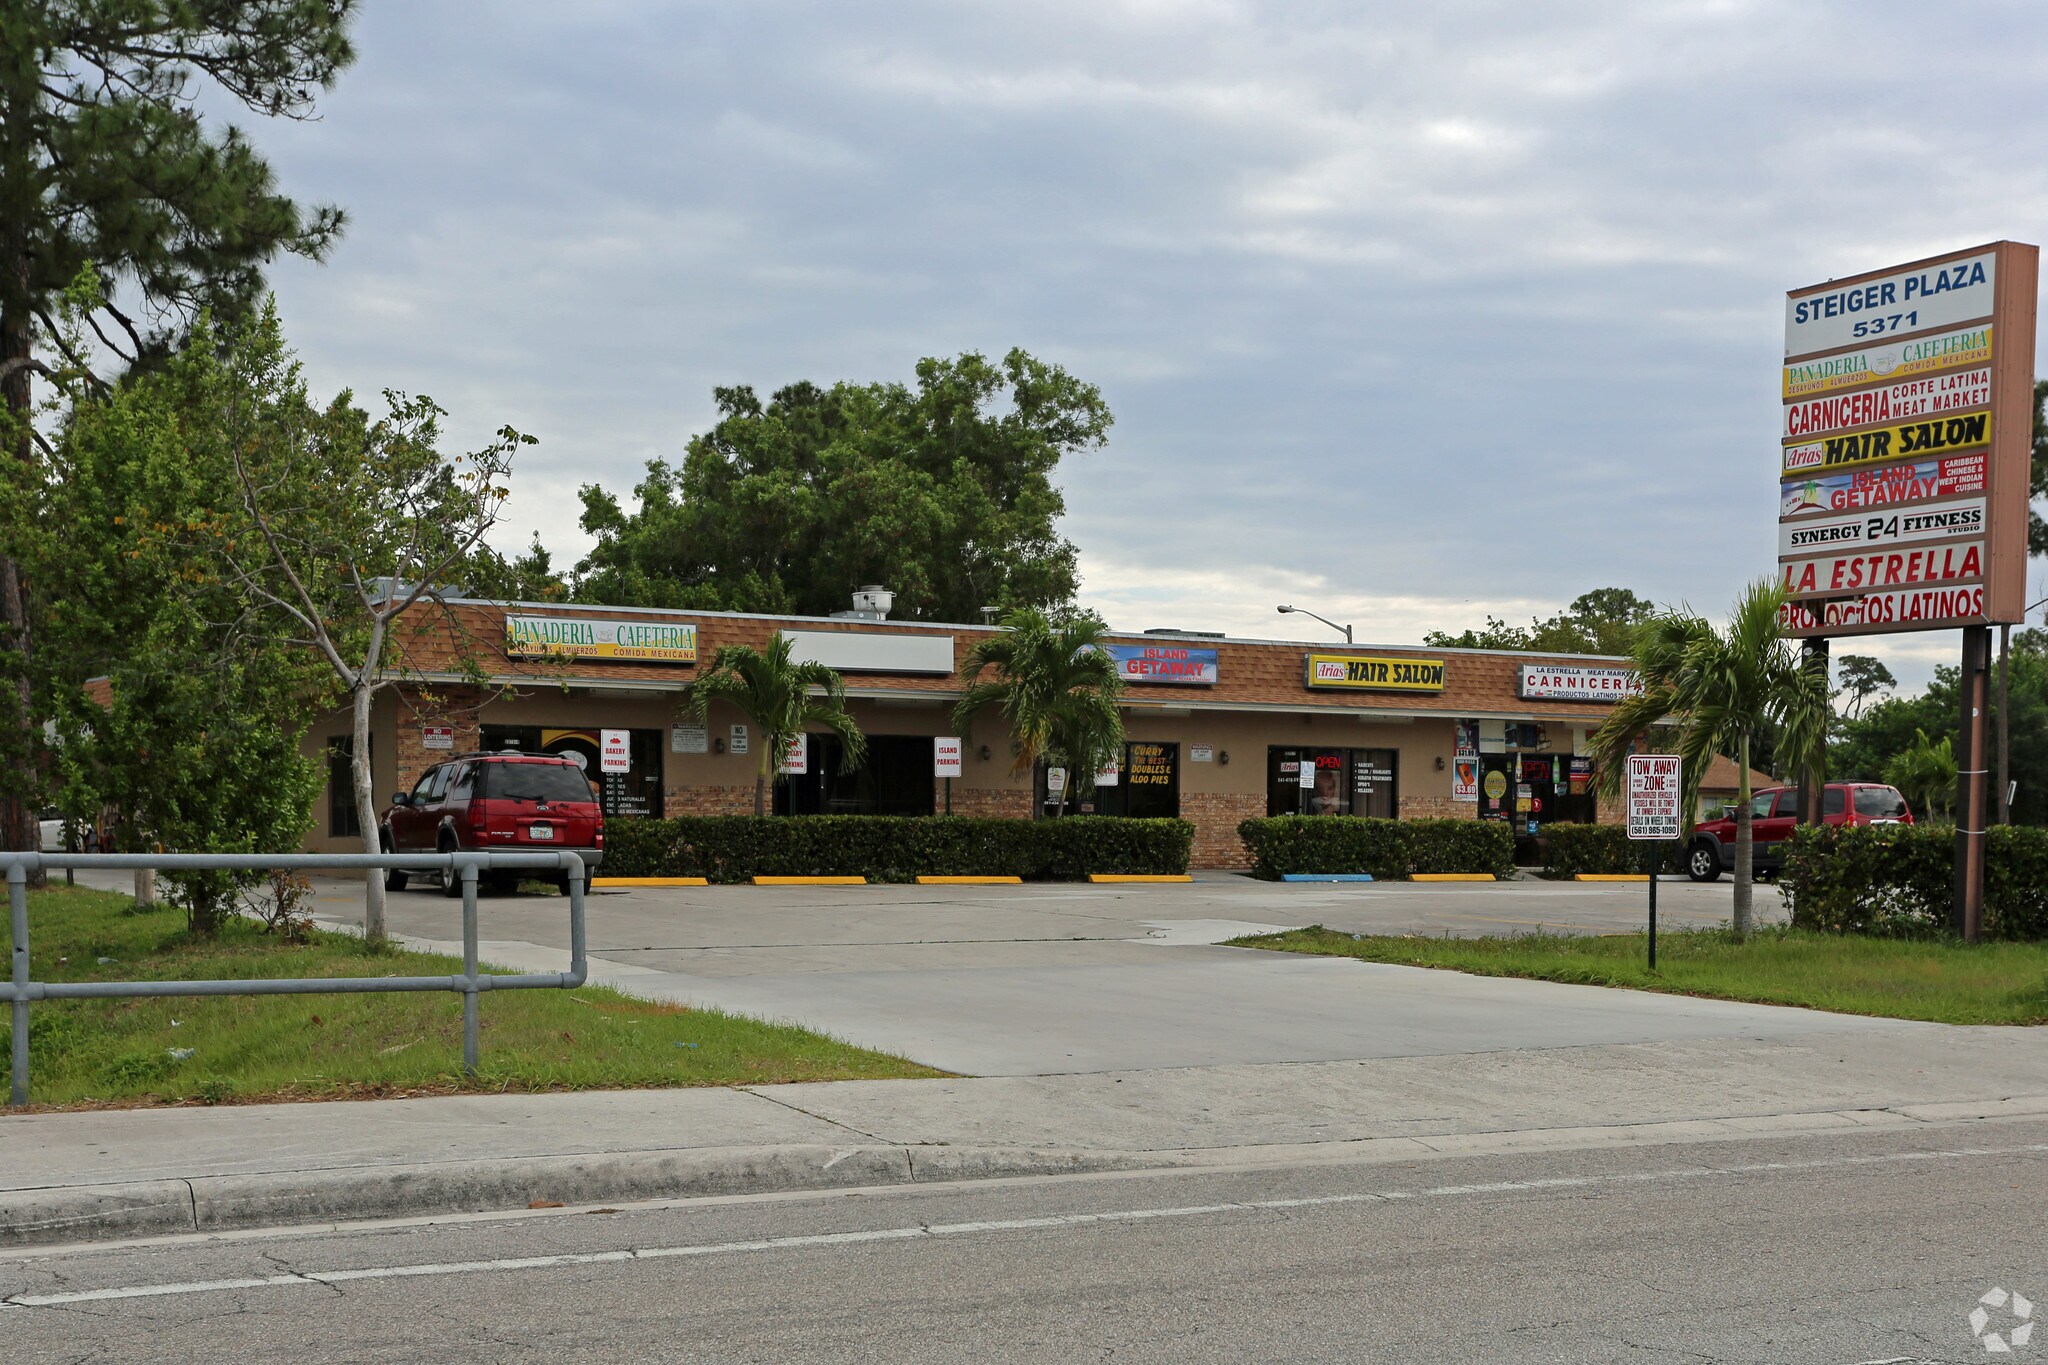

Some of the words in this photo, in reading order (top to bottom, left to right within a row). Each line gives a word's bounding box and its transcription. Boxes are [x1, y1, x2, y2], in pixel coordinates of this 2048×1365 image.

[1795, 282, 1896, 324] STEIGER
[1904, 262, 1986, 300] PLAZA
[1852, 311, 1918, 337] 5371
[1789, 355, 1868, 385] PANADERIA
[1903, 330, 1987, 363] CAFETERIA
[1788, 380, 1824, 394] DESAYUNOS
[1830, 373, 1868, 386] ALMUERZOS
[1903, 360, 1936, 372] COMIDA
[1942, 350, 1988, 365] MEXICANA
[1892, 380, 1934, 399] CORTE
[1941, 371, 1988, 390] LATINA
[1892, 399, 1926, 417] MEAT
[1933, 388, 1988, 411] MARKET
[1788, 390, 1891, 436] CARNICERIA
[1787, 445, 1822, 467] Aria's
[1824, 431, 1891, 465] HAIR
[1898, 414, 1986, 453] SALON
[1944, 456, 1984, 468] CARIBBEAN
[1946, 466, 1976, 476] CHINESE
[1852, 465, 1916, 488] ISLAND
[1939, 477, 1958, 486] WEST
[1959, 473, 1983, 484] INDIAN
[1831, 476, 1937, 509] GETAWAY
[1955, 482, 1983, 493] CUISINE
[1791, 525, 1862, 545] SYNERGY
[1867, 516, 1898, 540] 24
[1903, 509, 1981, 531] FITNESS
[1947, 525, 1980, 534] STUDIO
[1785, 562, 1816, 593] LA
[1830, 546, 1980, 589] ESTRELLA
[1900, 588, 1984, 621] LATINOS
[513, 620, 595, 645] PANADERIA
[616, 625, 693, 649] CAFETERIA
[613, 648, 647, 657] COMIDA
[650, 650, 695, 659] MEXICANA
[1143, 648, 1188, 660] ISLAND
[1126, 659, 1205, 676] GETAWAY
[1318, 664, 1344, 678] Aria's
[1348, 662, 1388, 682] HAIR
[1393, 664, 1443, 684] SALON
[1553, 690, 1589, 698] PRODUCTOS
[1134, 746, 1163, 756] CURRY
[1131, 765, 1164, 774] DOUBLES
[1316, 756, 1341, 768] OPEN
[1632, 760, 1650, 775] TOW
[1653, 760, 1677, 775] AWAY
[1130, 775, 1149, 784] ALOO
[1150, 775, 1169, 784] PIES
[1644, 775, 1665, 790] ZONE
